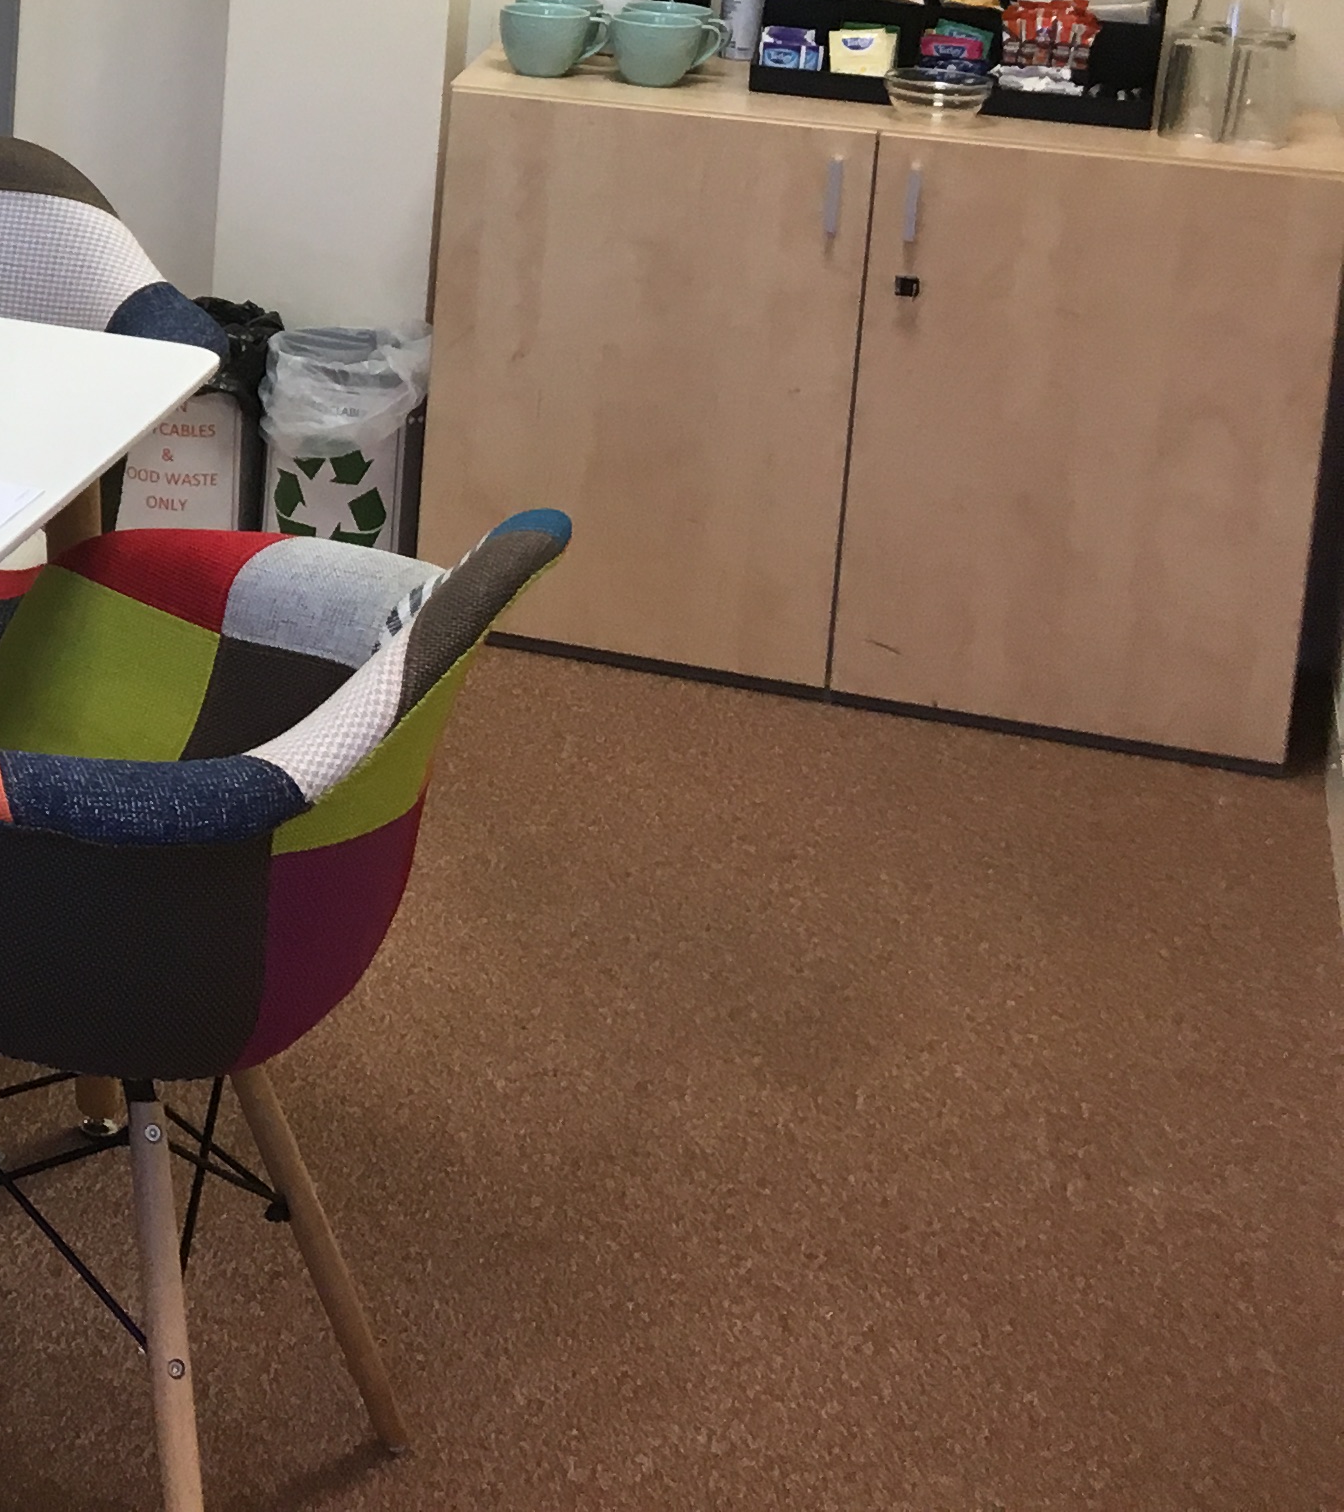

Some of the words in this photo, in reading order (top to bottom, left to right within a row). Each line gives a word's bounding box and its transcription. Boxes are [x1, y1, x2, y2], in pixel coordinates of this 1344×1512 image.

[153, 423, 216, 438] CABLES
[161, 448, 174, 461] &
[127, 466, 160, 483] OOD
[165, 472, 218, 487] WASTE
[146, 495, 188, 511] ONLY
